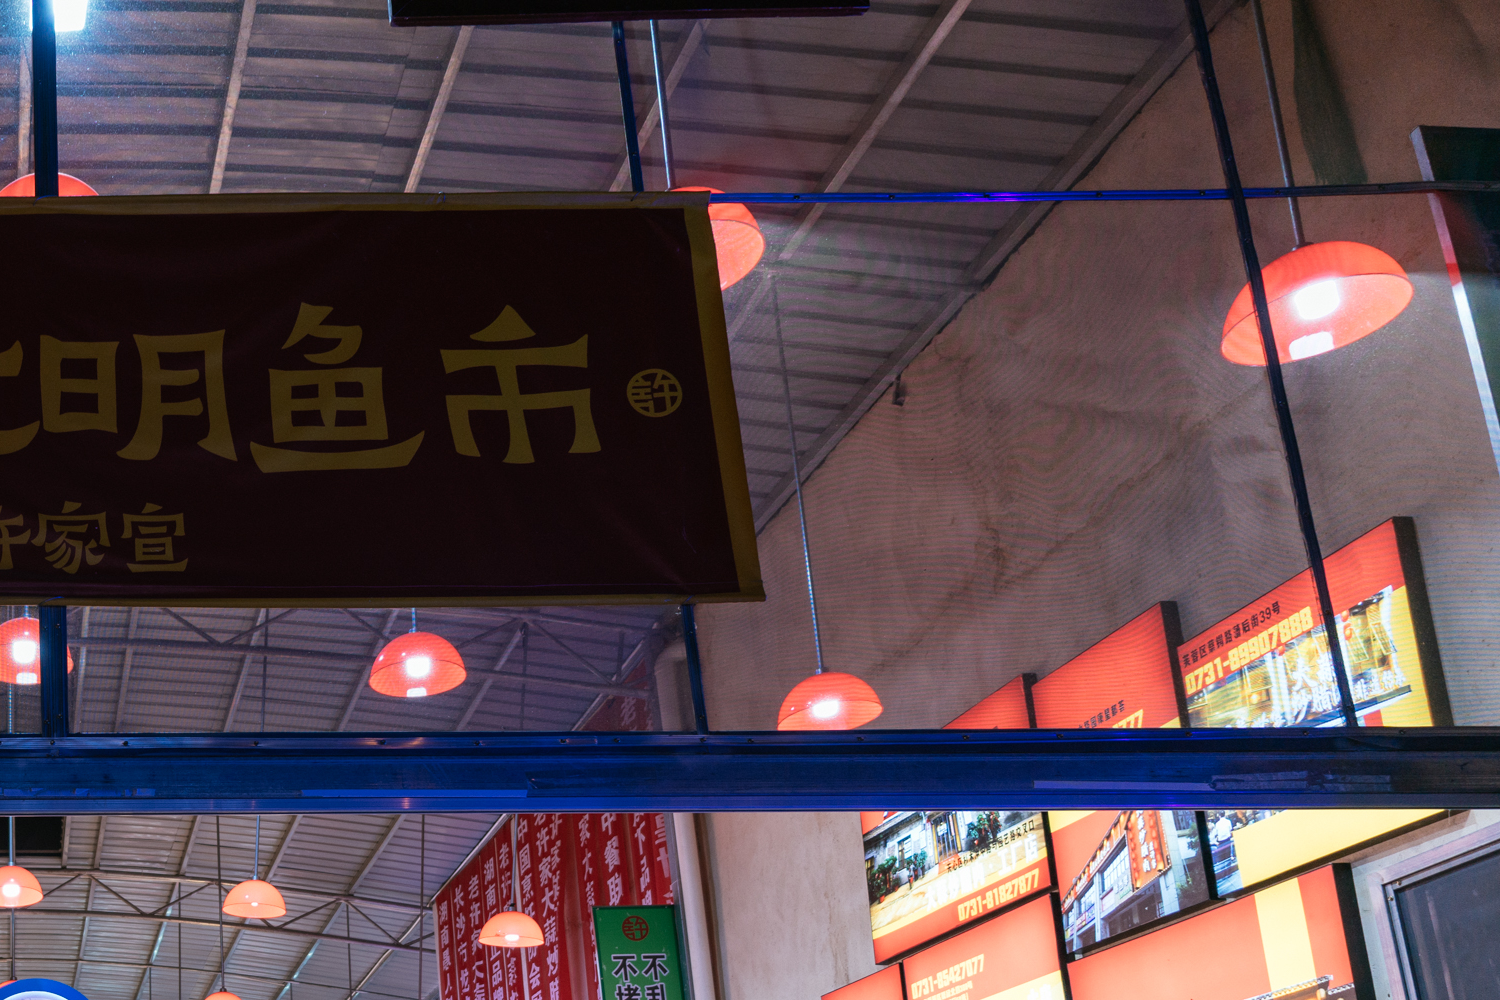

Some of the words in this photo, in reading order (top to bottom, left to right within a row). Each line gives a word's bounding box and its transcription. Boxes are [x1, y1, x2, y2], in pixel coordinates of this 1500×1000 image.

[1184, 606, 1314, 695] 0731-89907888
[957, 868, 1040, 922] 0731-81827877
[911, 953, 985, 1000] 0731-85427077
